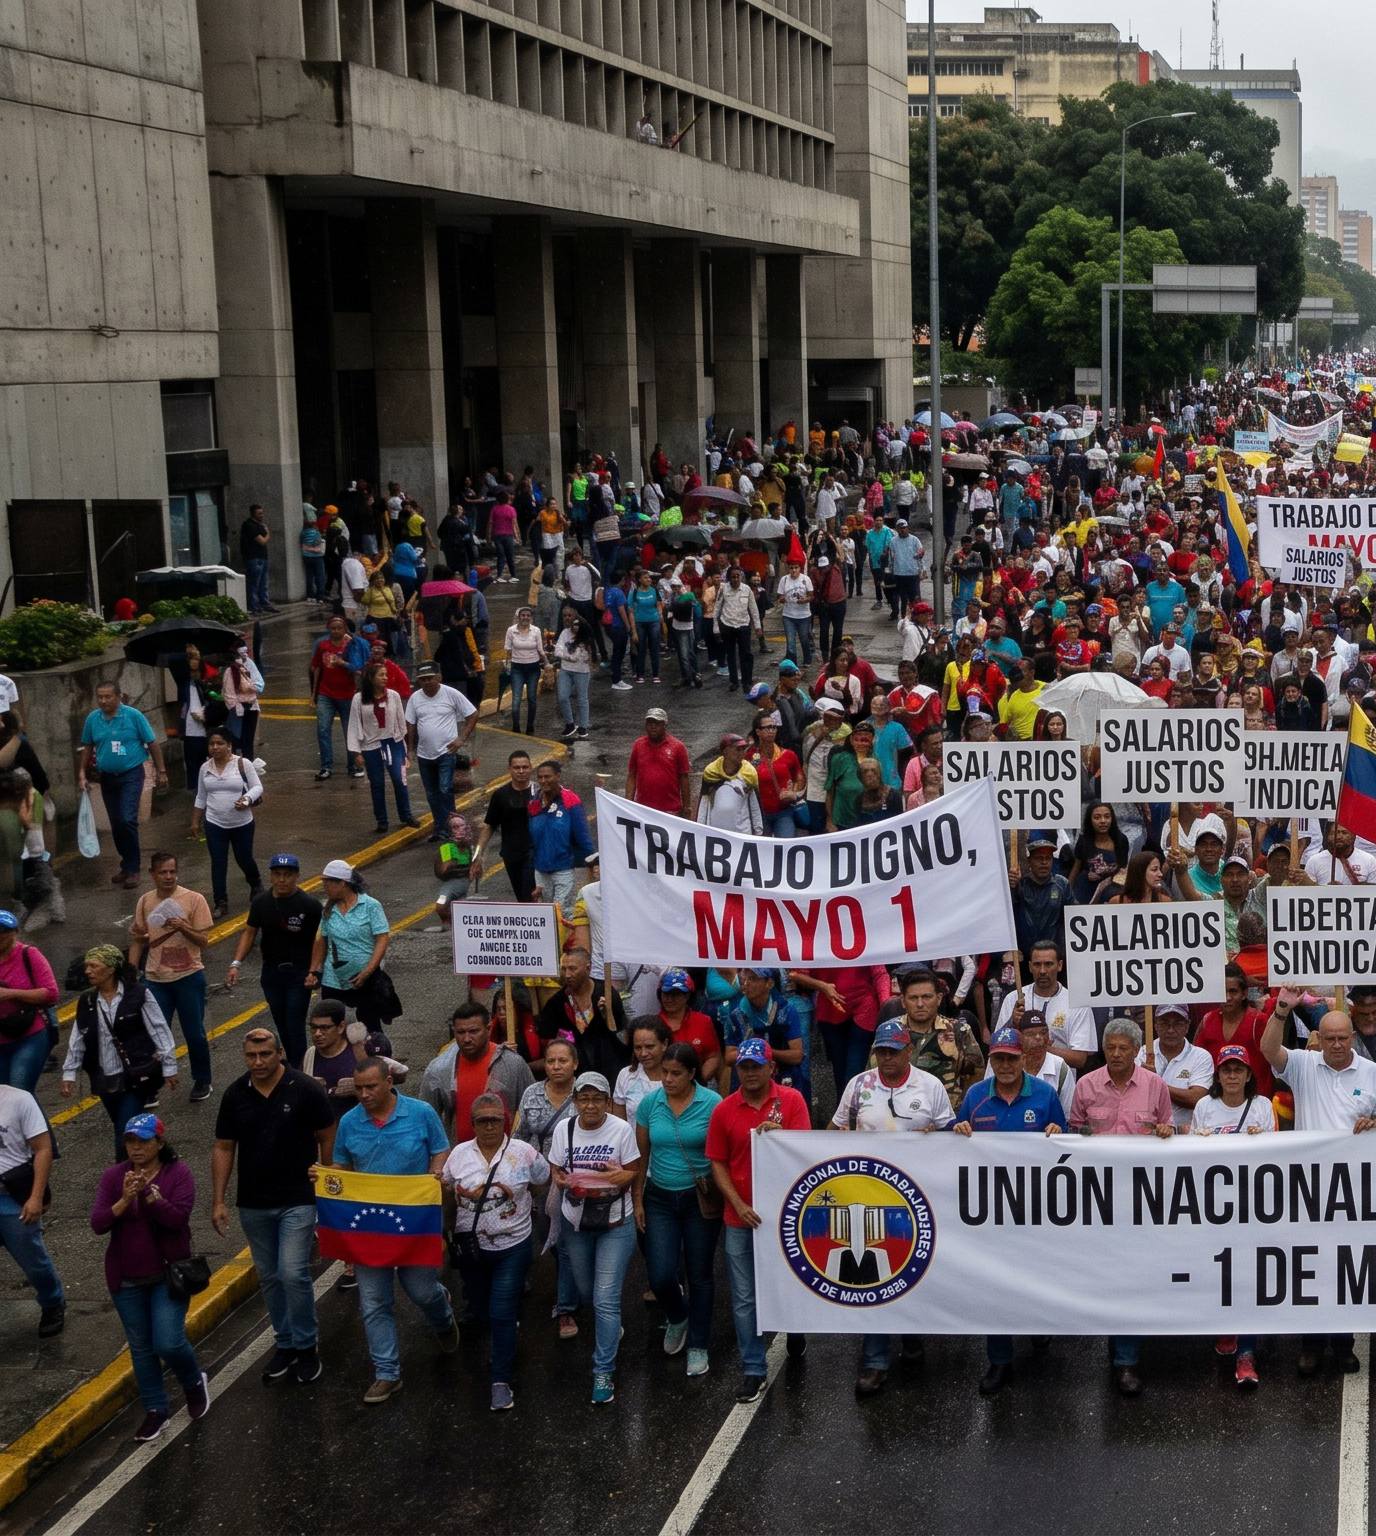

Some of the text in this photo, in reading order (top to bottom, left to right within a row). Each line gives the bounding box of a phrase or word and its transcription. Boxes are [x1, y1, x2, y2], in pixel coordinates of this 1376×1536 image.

[1269, 503, 1361, 528] TRABAJO
[1286, 547, 1344, 567] SALARIOS
[1292, 566, 1336, 584] JUSTOS
[1104, 718, 1241, 753] SALARIOS
[1122, 760, 1225, 794] JUSTOS
[997, 788, 1065, 821] STOS
[616, 812, 977, 890] TRABAJO DIGNO,
[693, 885, 919, 961] MAYO 1
[1069, 911, 1221, 952] SALARIOS
[1090, 956, 1204, 997] JUSTOS
[849, 1160, 868, 1172] DE
[958, 1154, 1113, 1225] UNIÓN
[811, 1277, 819, 1286] 1
[819, 1282, 838, 1298] DE
[840, 1290, 876, 1303] MAYO
[1213, 1247, 1232, 1306] 1
[1256, 1245, 1319, 1306] DE
